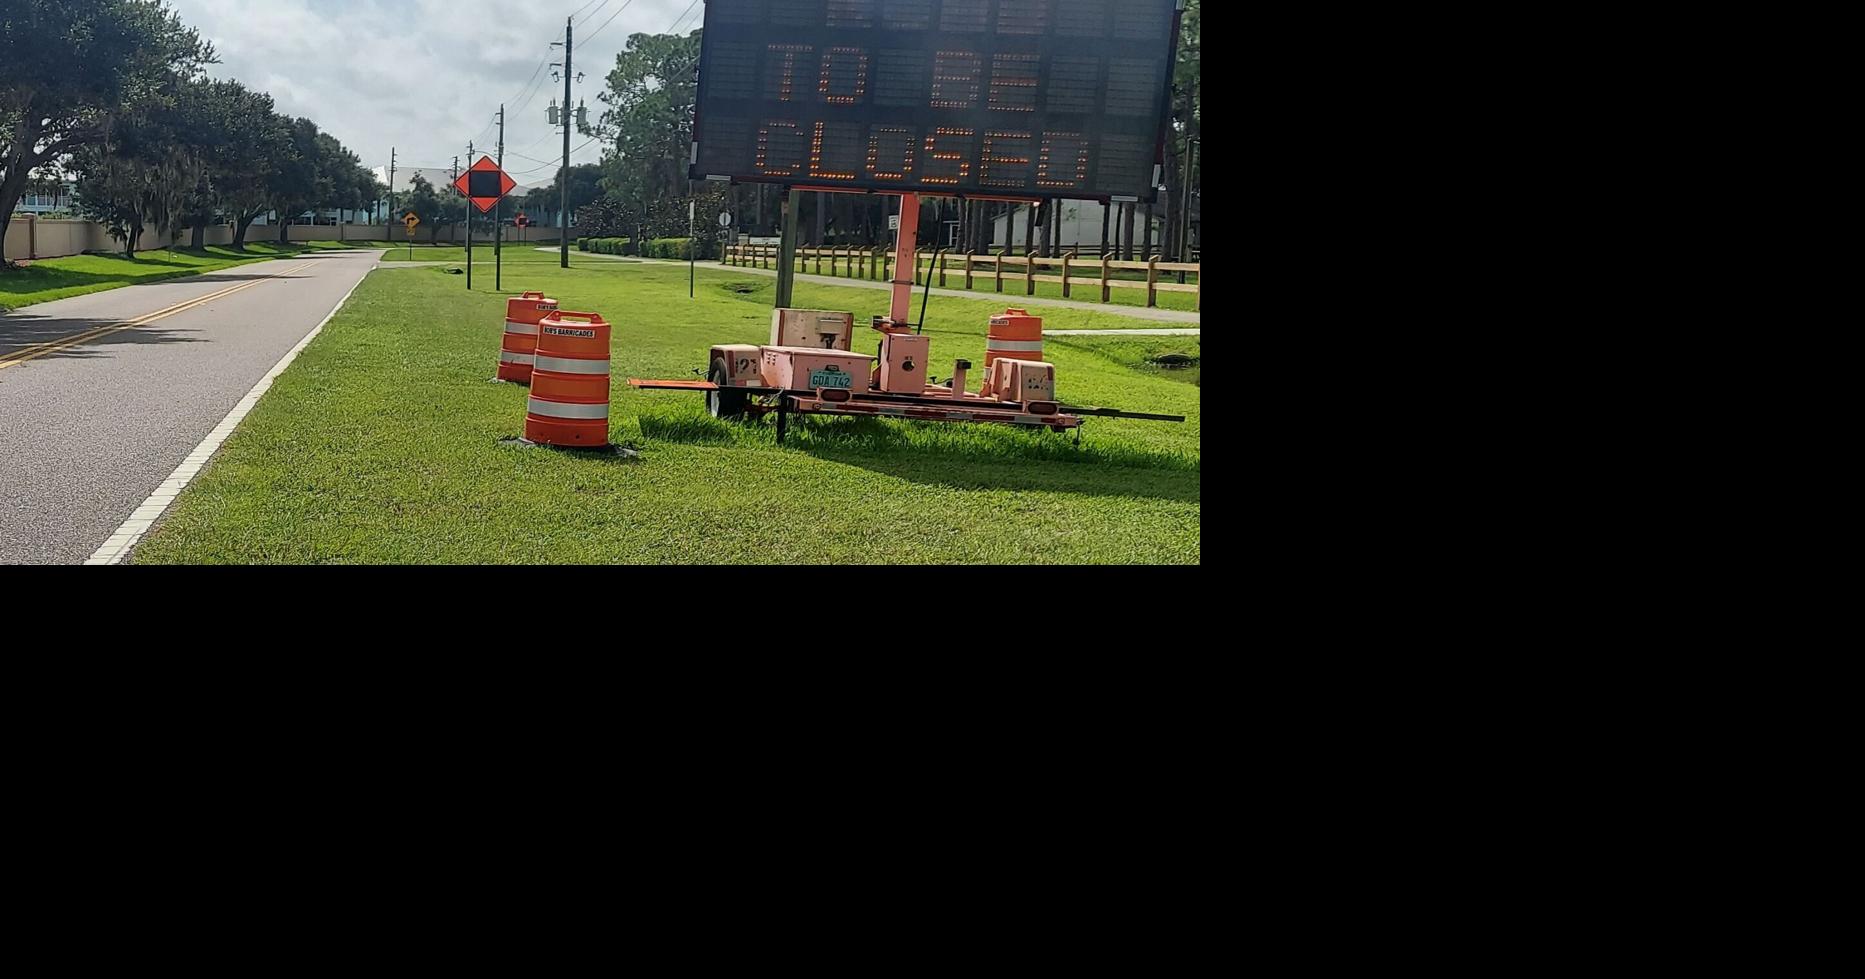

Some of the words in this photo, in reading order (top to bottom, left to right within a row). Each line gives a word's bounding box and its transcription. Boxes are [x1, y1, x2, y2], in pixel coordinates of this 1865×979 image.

[767, 44, 868, 103] TO
[930, 49, 1041, 111] BE
[755, 121, 1089, 188] CLOSED
[558, 329, 593, 337] BARRICADES
[833, 376, 850, 388] 742
